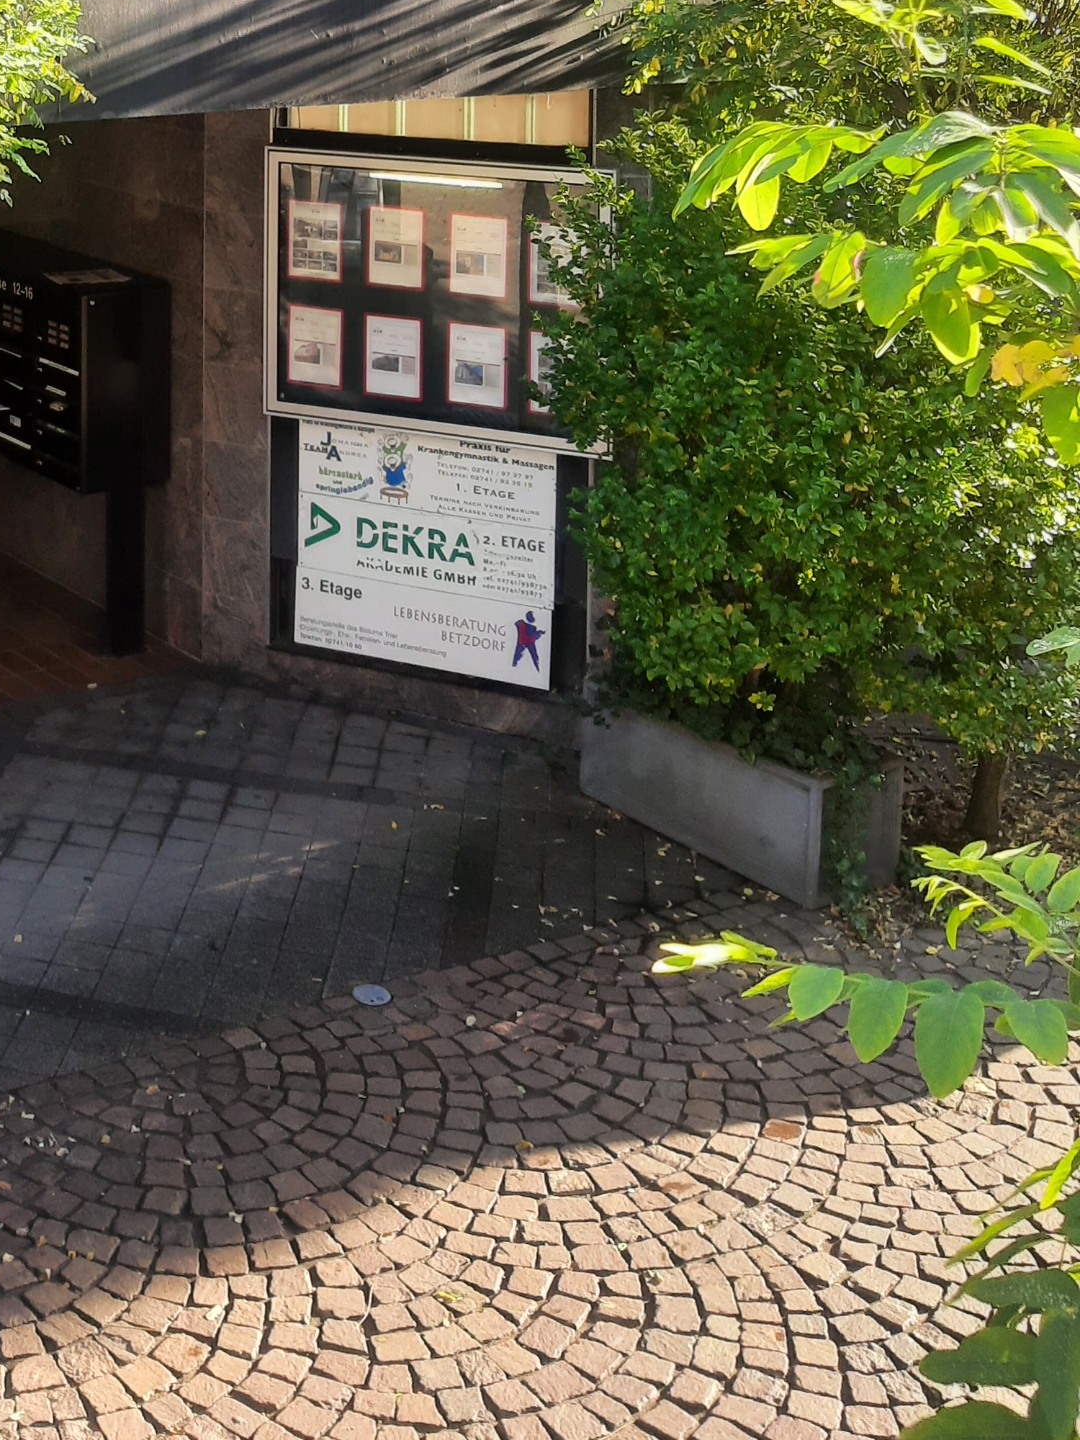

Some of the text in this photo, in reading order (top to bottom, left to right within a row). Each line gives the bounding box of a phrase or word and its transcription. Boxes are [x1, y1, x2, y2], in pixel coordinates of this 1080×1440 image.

[12, 281, 33, 300] 12-16
[460, 440, 491, 451] Praxis
[417, 445, 555, 471] Krankengymnastik & Massagen
[470, 474, 493, 483] 02741
[471, 467, 494, 475] 02741
[456, 483, 516, 500] 1. ETAGE
[356, 516, 476, 567] DEKRA
[482, 535, 546, 553] 2. ETAGE
[433, 569, 477, 586] GMBH
[301, 576, 363, 601] 3. Etage
[347, 624, 358, 632] des
[393, 605, 507, 637] LEBENSBERATUNG
[441, 630, 506, 652] BETZDORF
[397, 642, 447, 658] Lebensberatung
